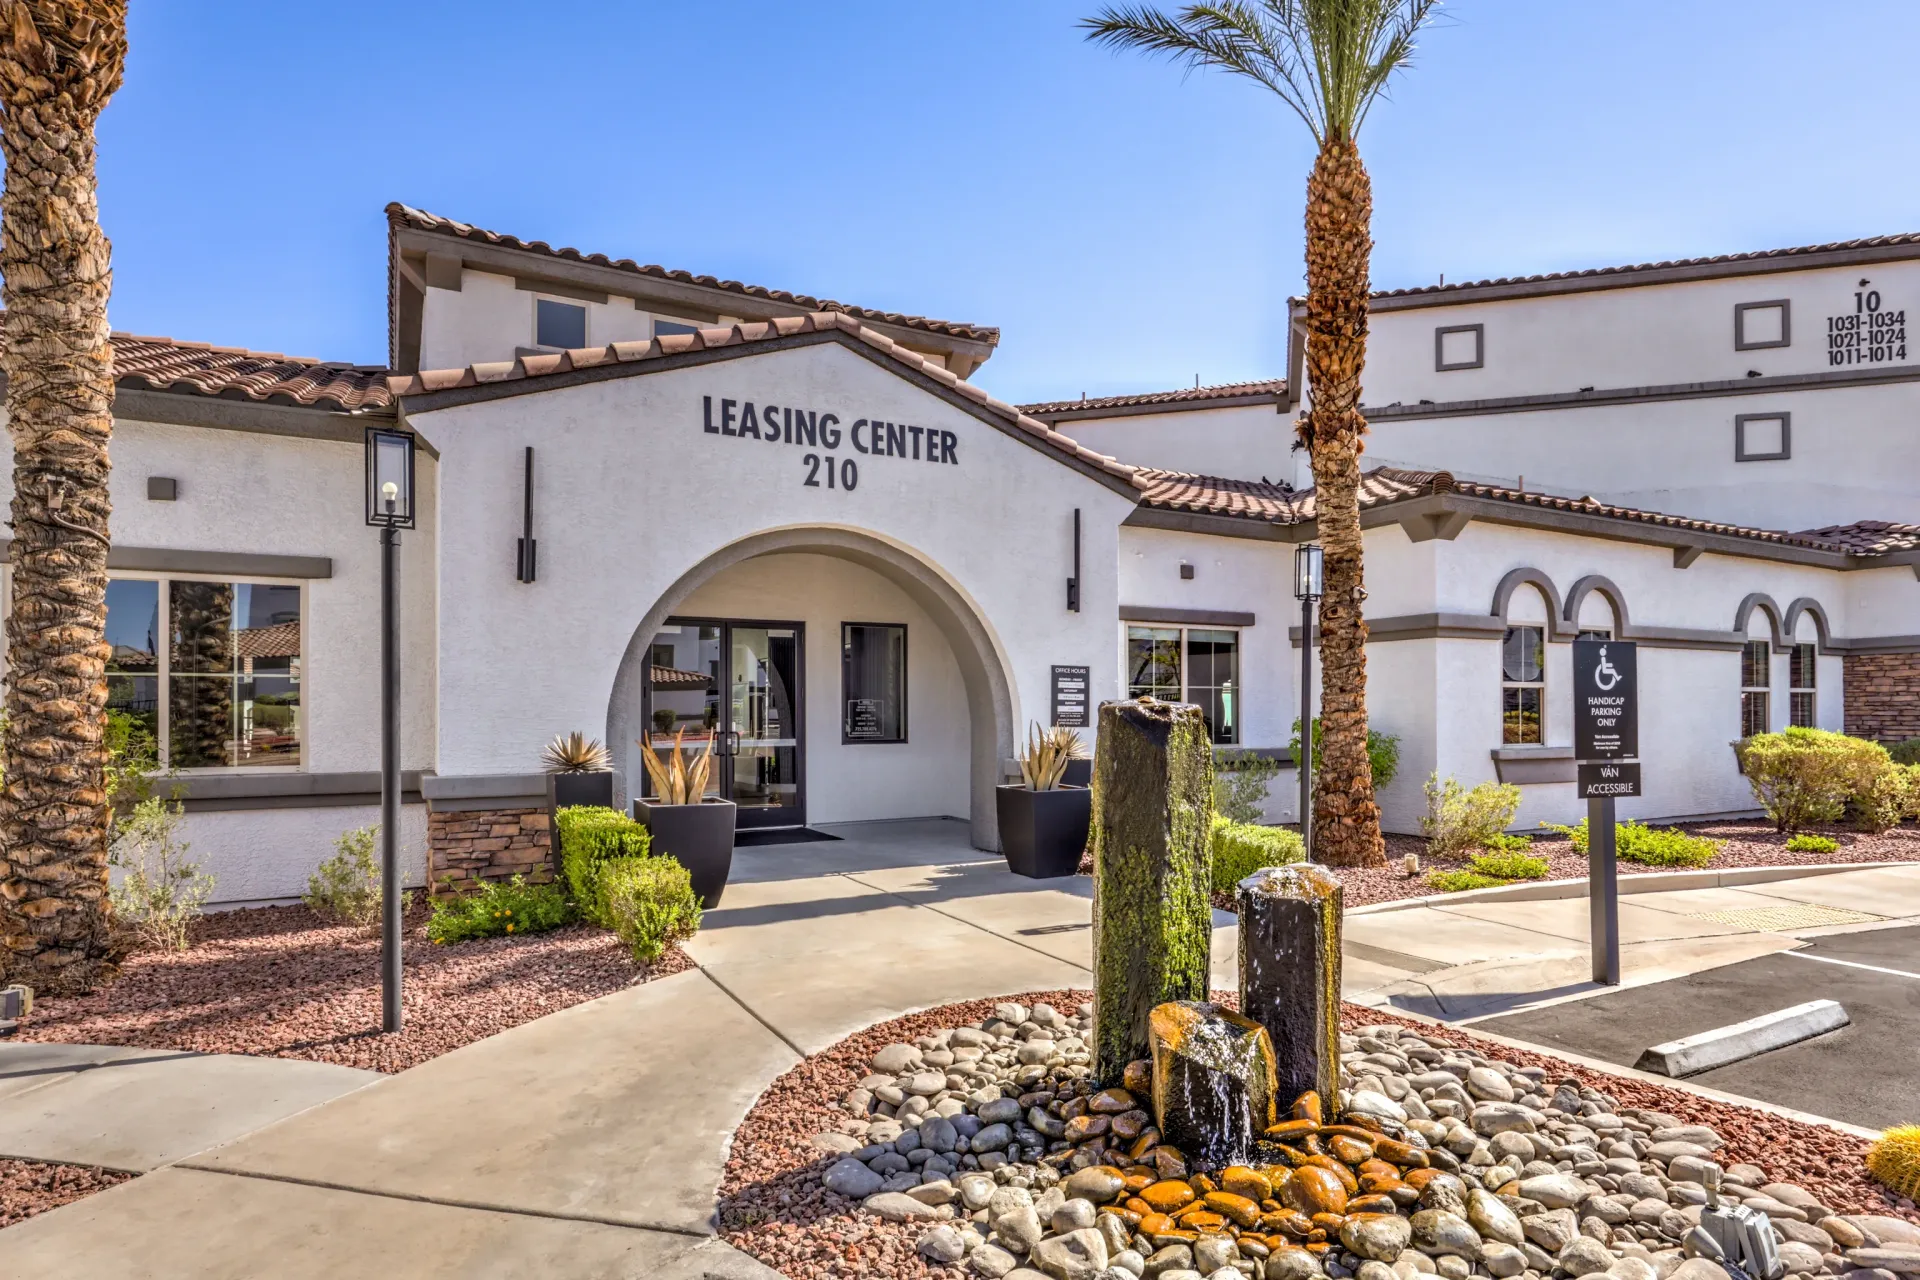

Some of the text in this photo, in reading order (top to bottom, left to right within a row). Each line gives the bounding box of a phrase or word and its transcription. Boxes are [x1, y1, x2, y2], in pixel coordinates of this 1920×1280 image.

[1854, 290, 1881, 313] 10
[1827, 310, 1905, 332] 1031-1034
[1827, 327, 1906, 349] 1021-1024
[1827, 344, 1907, 366] 1011-1014
[703, 395, 959, 465] LEASING CENTER
[803, 453, 858, 491] 210
[1588, 696, 1625, 705] HANDICAP
[1591, 707, 1622, 716] PARKING
[1597, 718, 1616, 727] ONLY
[1600, 767, 1619, 778] VAN
[1587, 783, 1633, 794] ACCESSIBLE
